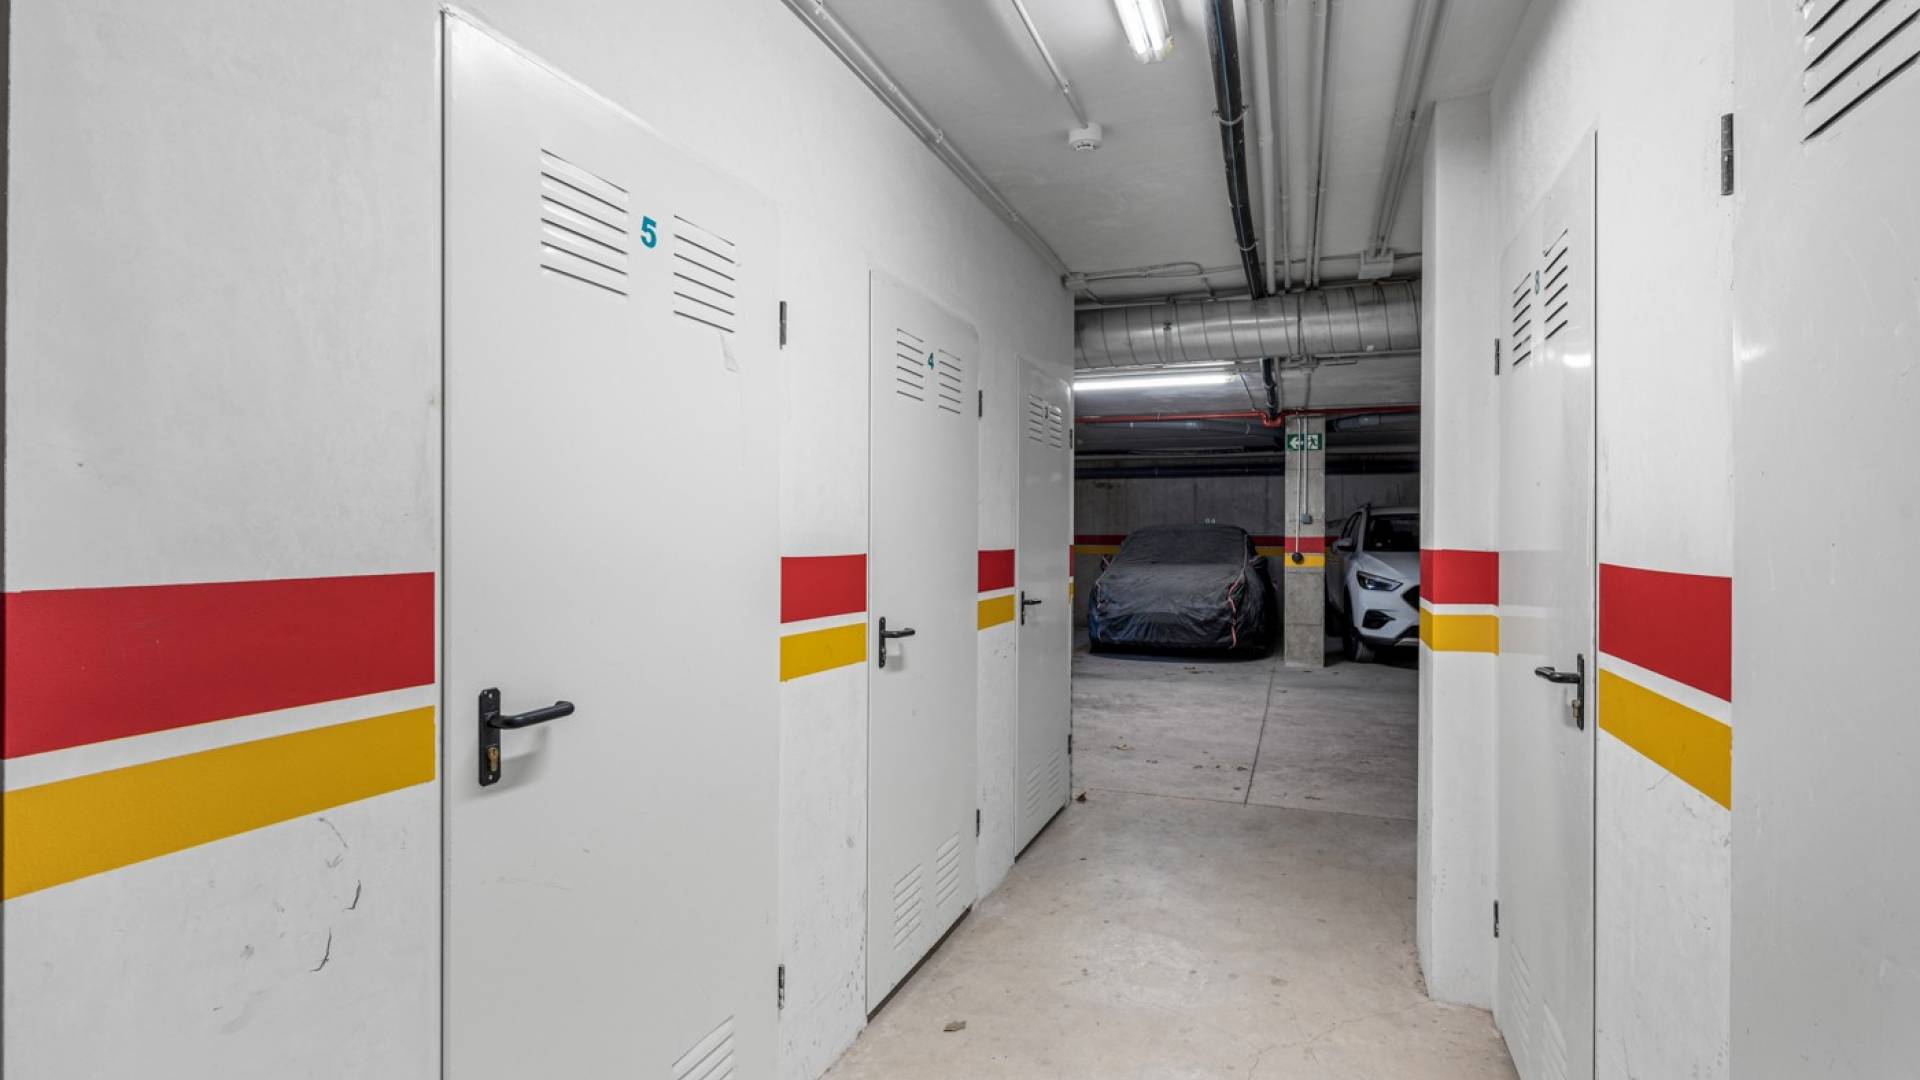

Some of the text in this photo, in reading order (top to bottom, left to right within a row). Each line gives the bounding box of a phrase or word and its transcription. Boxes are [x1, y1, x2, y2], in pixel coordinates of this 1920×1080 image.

[641, 215, 657, 249] 5
[1535, 270, 1540, 295] 8
[927, 352, 935, 370] 4
